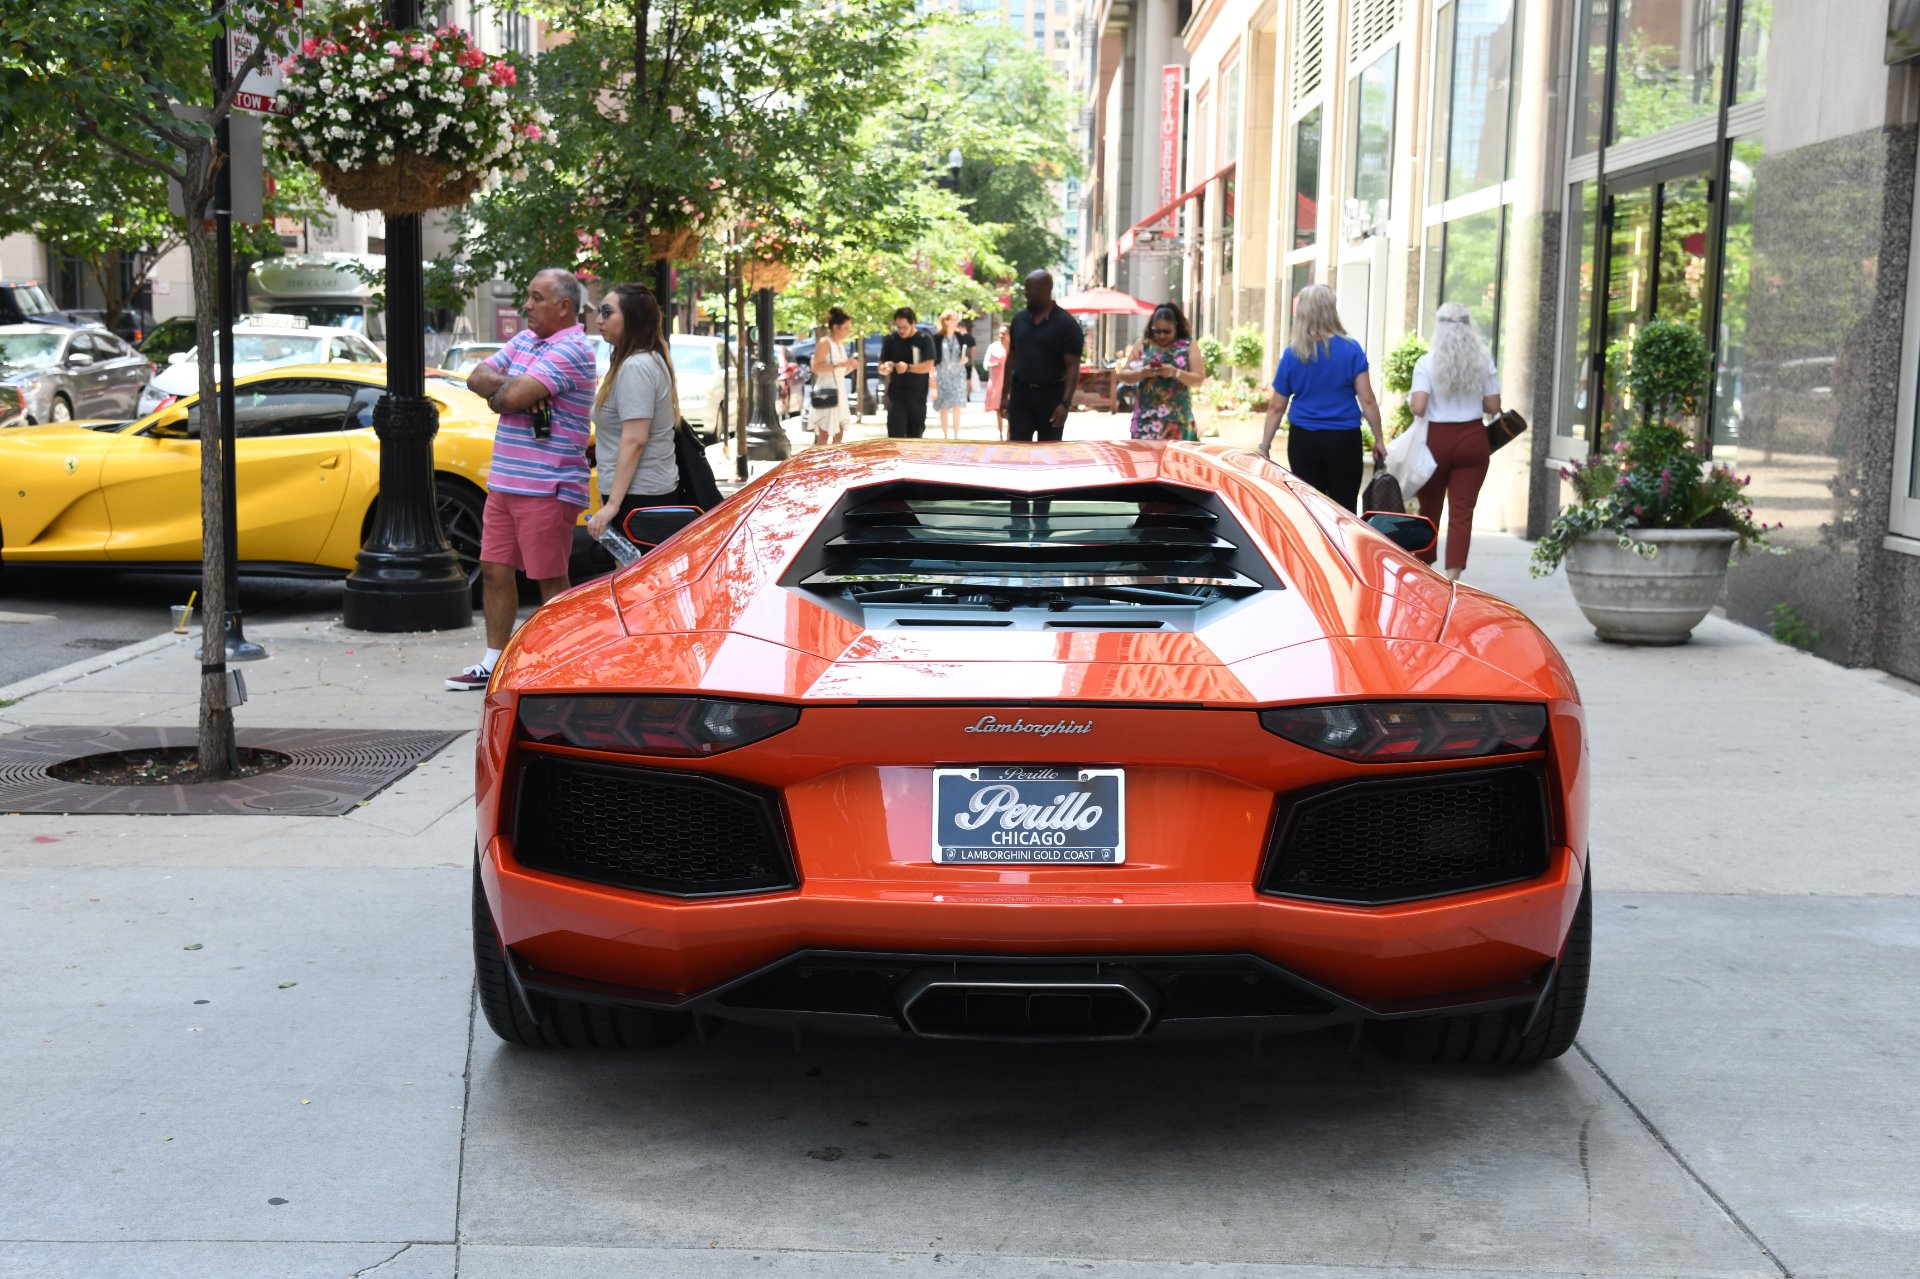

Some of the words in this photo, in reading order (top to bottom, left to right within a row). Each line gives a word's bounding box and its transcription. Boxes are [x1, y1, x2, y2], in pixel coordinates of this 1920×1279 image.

[236, 92, 262, 109] TOW
[1161, 140, 1173, 229] BURGR
[964, 715, 1093, 737] Lamborghini
[999, 767, 1059, 780] Perillo
[954, 784, 1103, 830] Perillo
[991, 831, 1066, 845] CHICAGO
[961, 850, 1031, 860] LAMBORGHINI
[1033, 850, 1061, 860] GOLD
[1063, 850, 1095, 860] COAST
